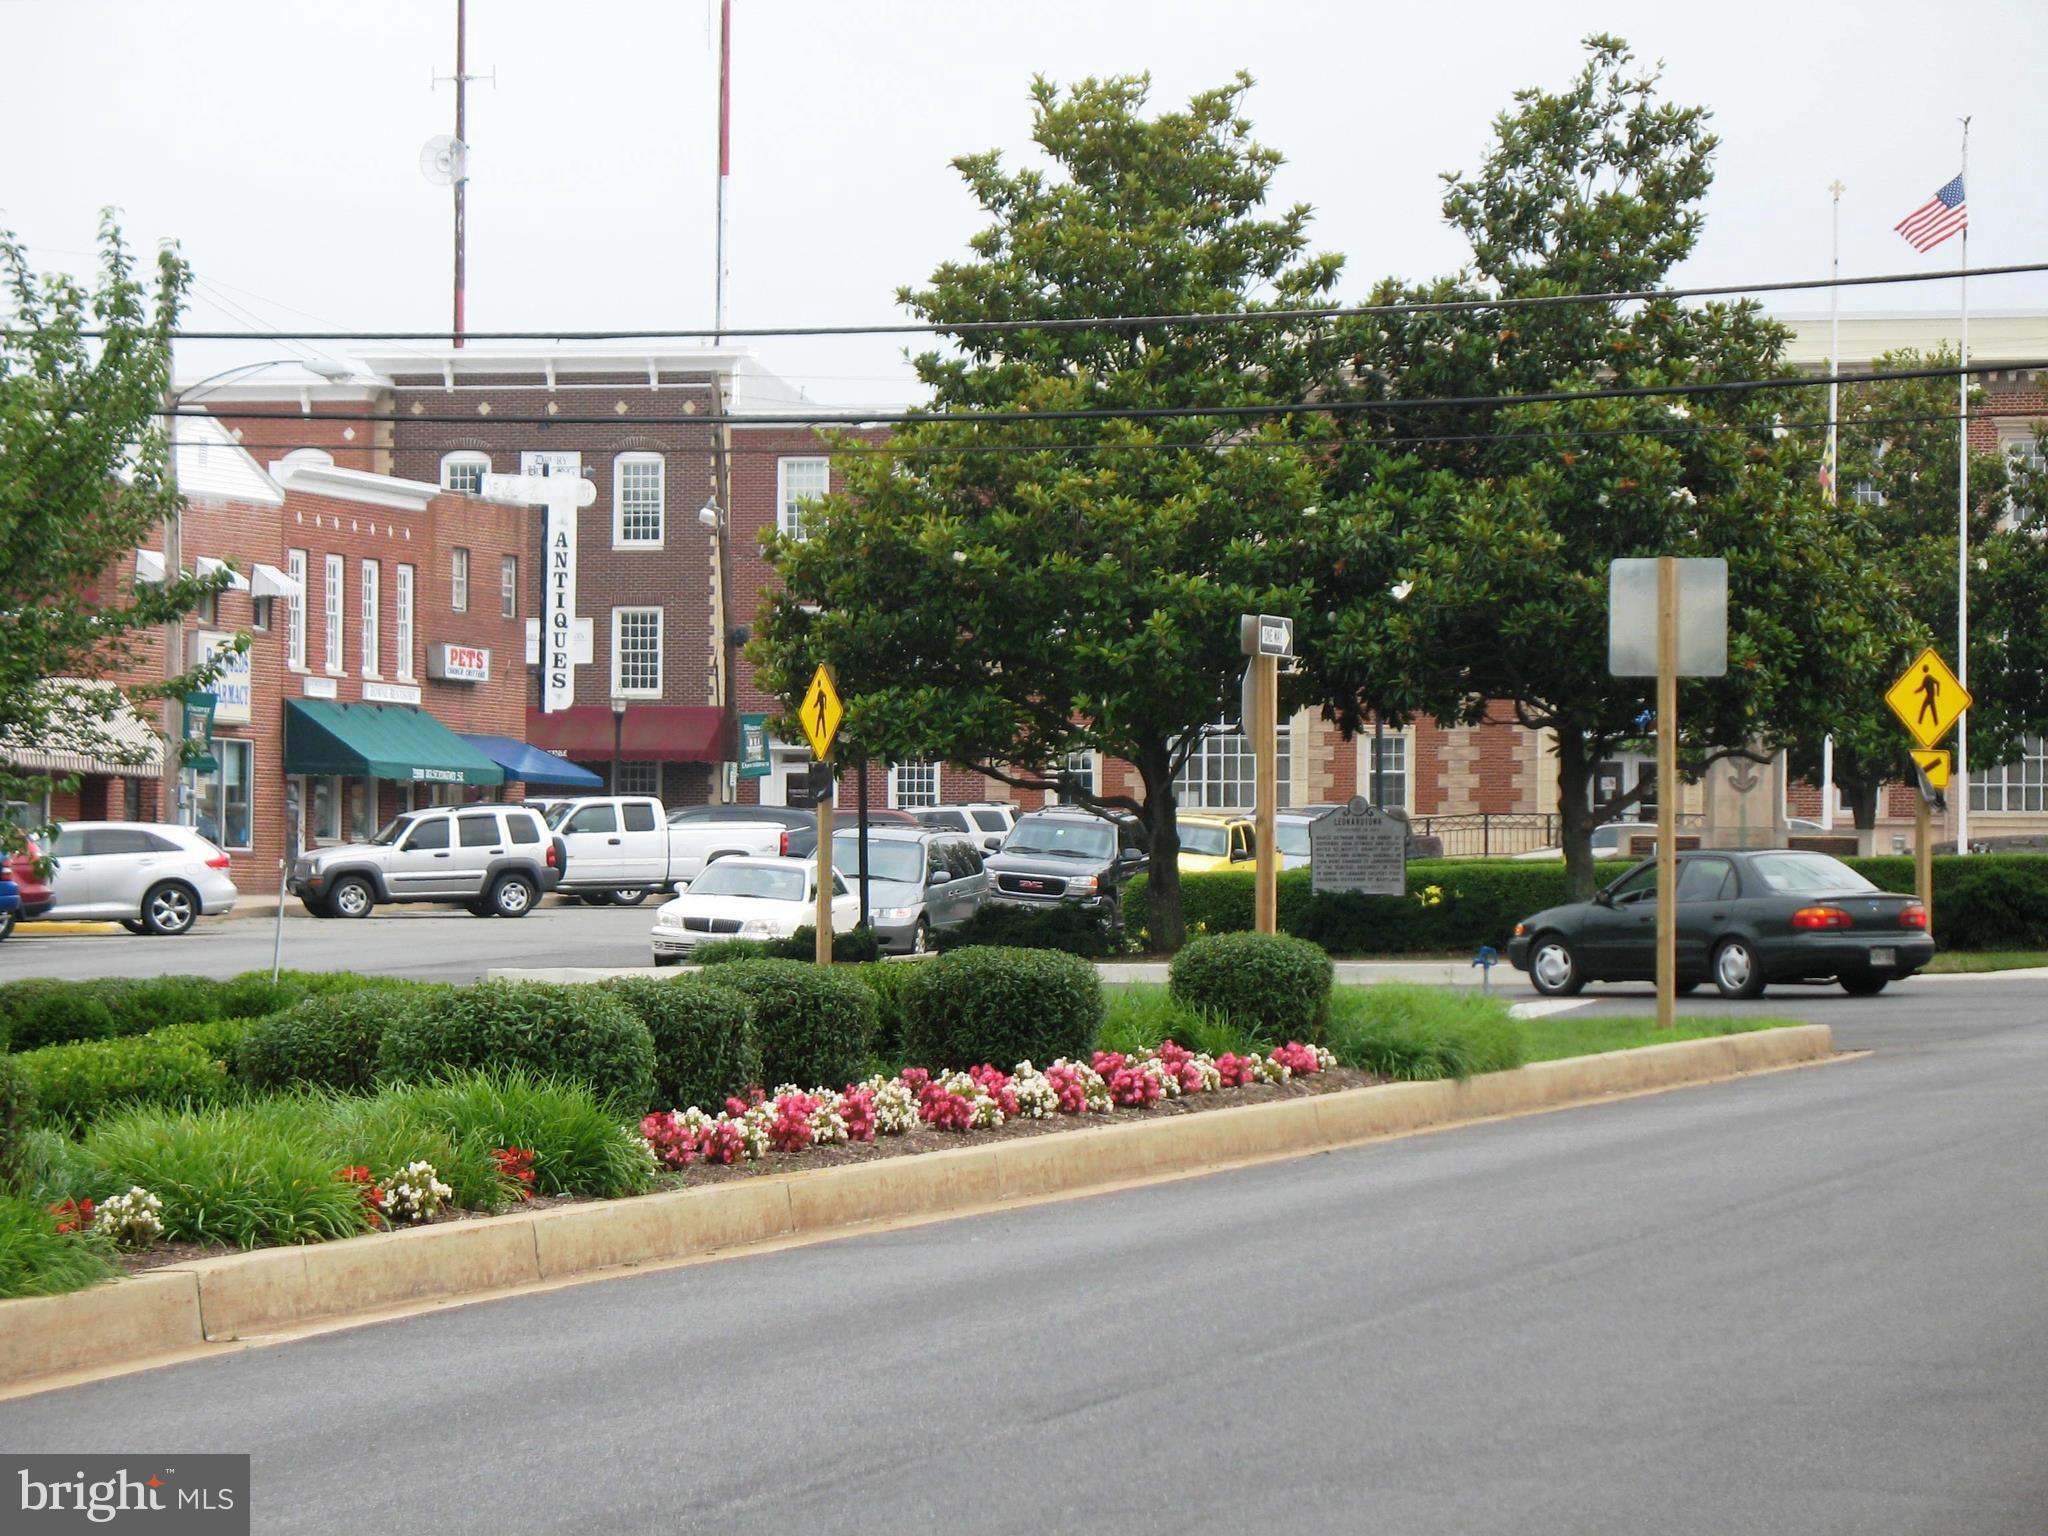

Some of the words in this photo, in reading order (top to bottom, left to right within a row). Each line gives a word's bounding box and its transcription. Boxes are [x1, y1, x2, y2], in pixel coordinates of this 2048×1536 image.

[551, 531, 569, 689] ANTIQUES
[1264, 628, 1273, 643] ONE
[449, 647, 484, 670] PETS
